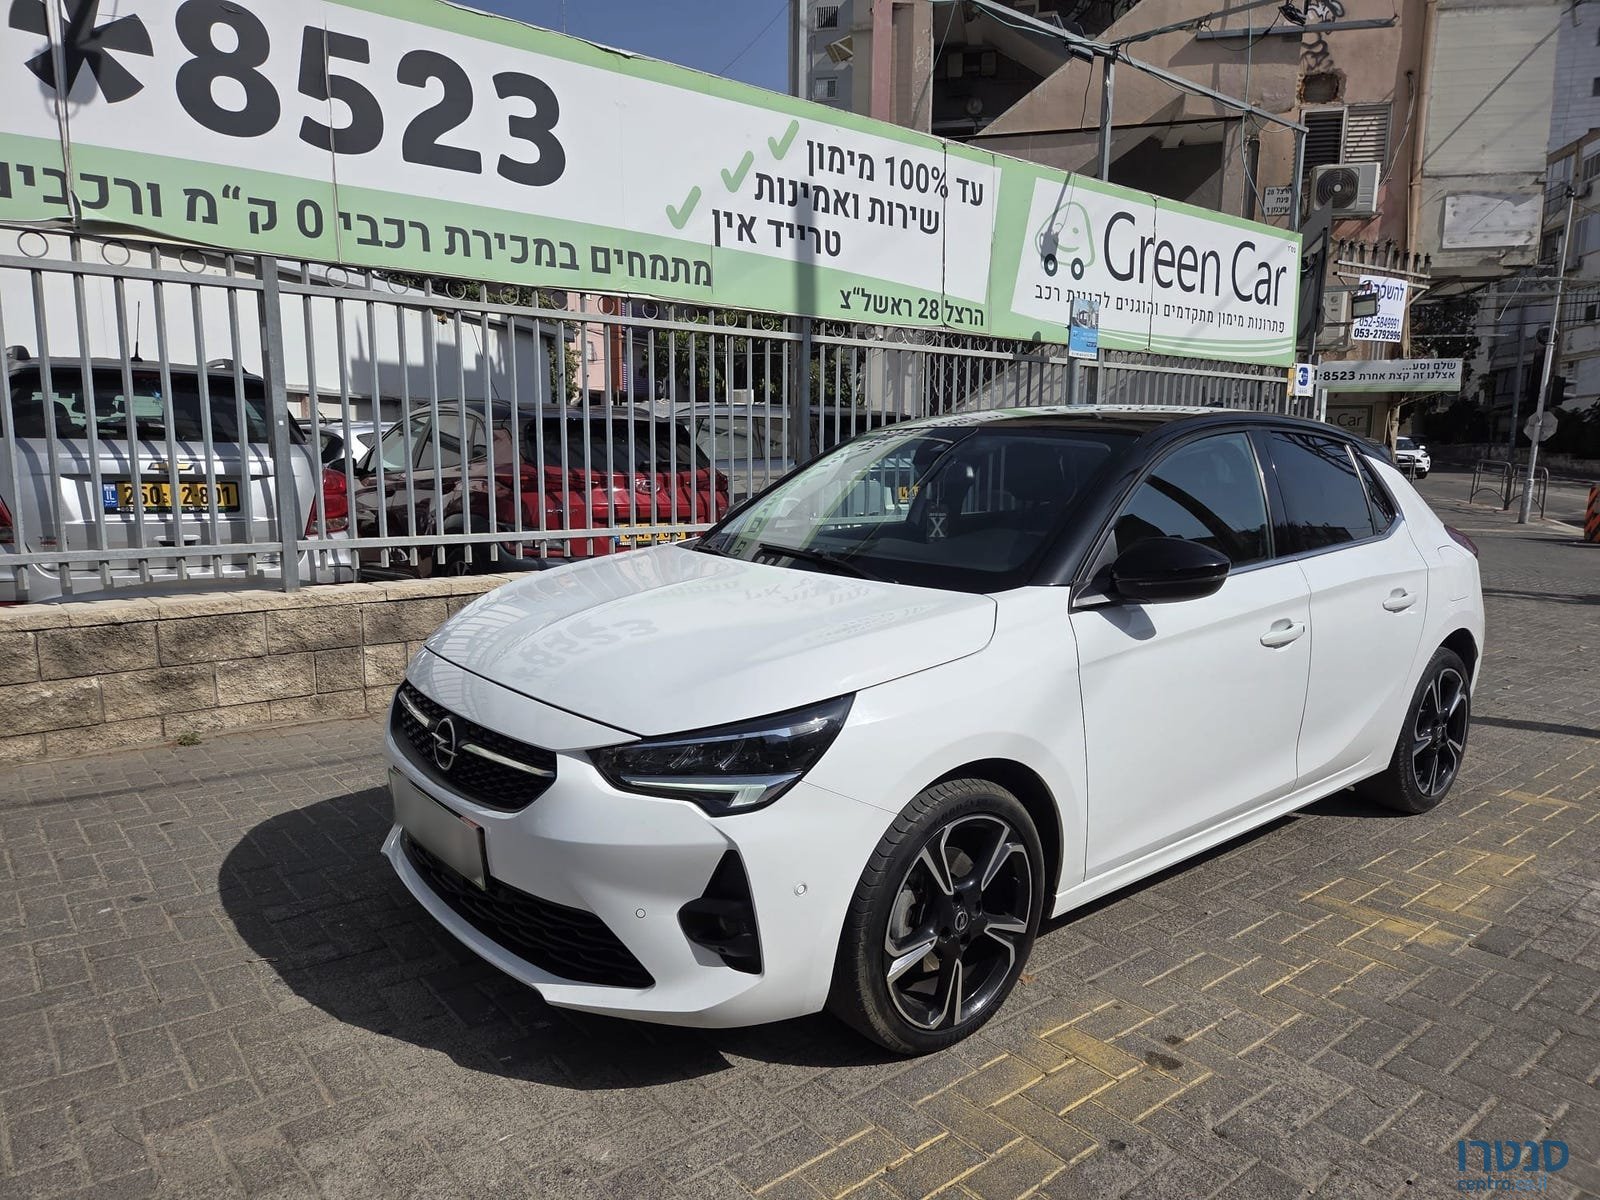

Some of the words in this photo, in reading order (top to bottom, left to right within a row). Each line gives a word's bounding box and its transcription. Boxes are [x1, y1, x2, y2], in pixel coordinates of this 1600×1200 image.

[806, 140, 875, 182] מימון
[886, 156, 949, 200] 100%
[957, 178, 983, 206] עד
[755, 172, 859, 220] ואמינות
[297, 199, 324, 239] 0
[712, 209, 757, 247] אין
[868, 196, 940, 236] שירות
[338, 211, 431, 253] רכבי
[768, 219, 841, 257] טרייד
[445, 225, 580, 271] במכירת
[1104, 212, 1221, 298] Green
[1232, 241, 1287, 307] Car
[591, 246, 712, 287] מתמחים
[1035, 284, 1060, 302] רכב
[1116, 297, 1158, 316] והוגנים
[919, 297, 939, 321] 28
[945, 300, 984, 329] הרצל
[1164, 304, 1214, 324] מתקדמים
[1218, 312, 1244, 328] מימון
[1247, 316, 1285, 333] פתרונות
[1358, 372, 1386, 381] אחרת
[1388, 372, 1410, 381] קצת
[1412, 371, 1424, 380] זה
[1427, 370, 1456, 379] אצלנו
[1433, 361, 1456, 370] שלם
[1336, 412, 1363, 427] Car
